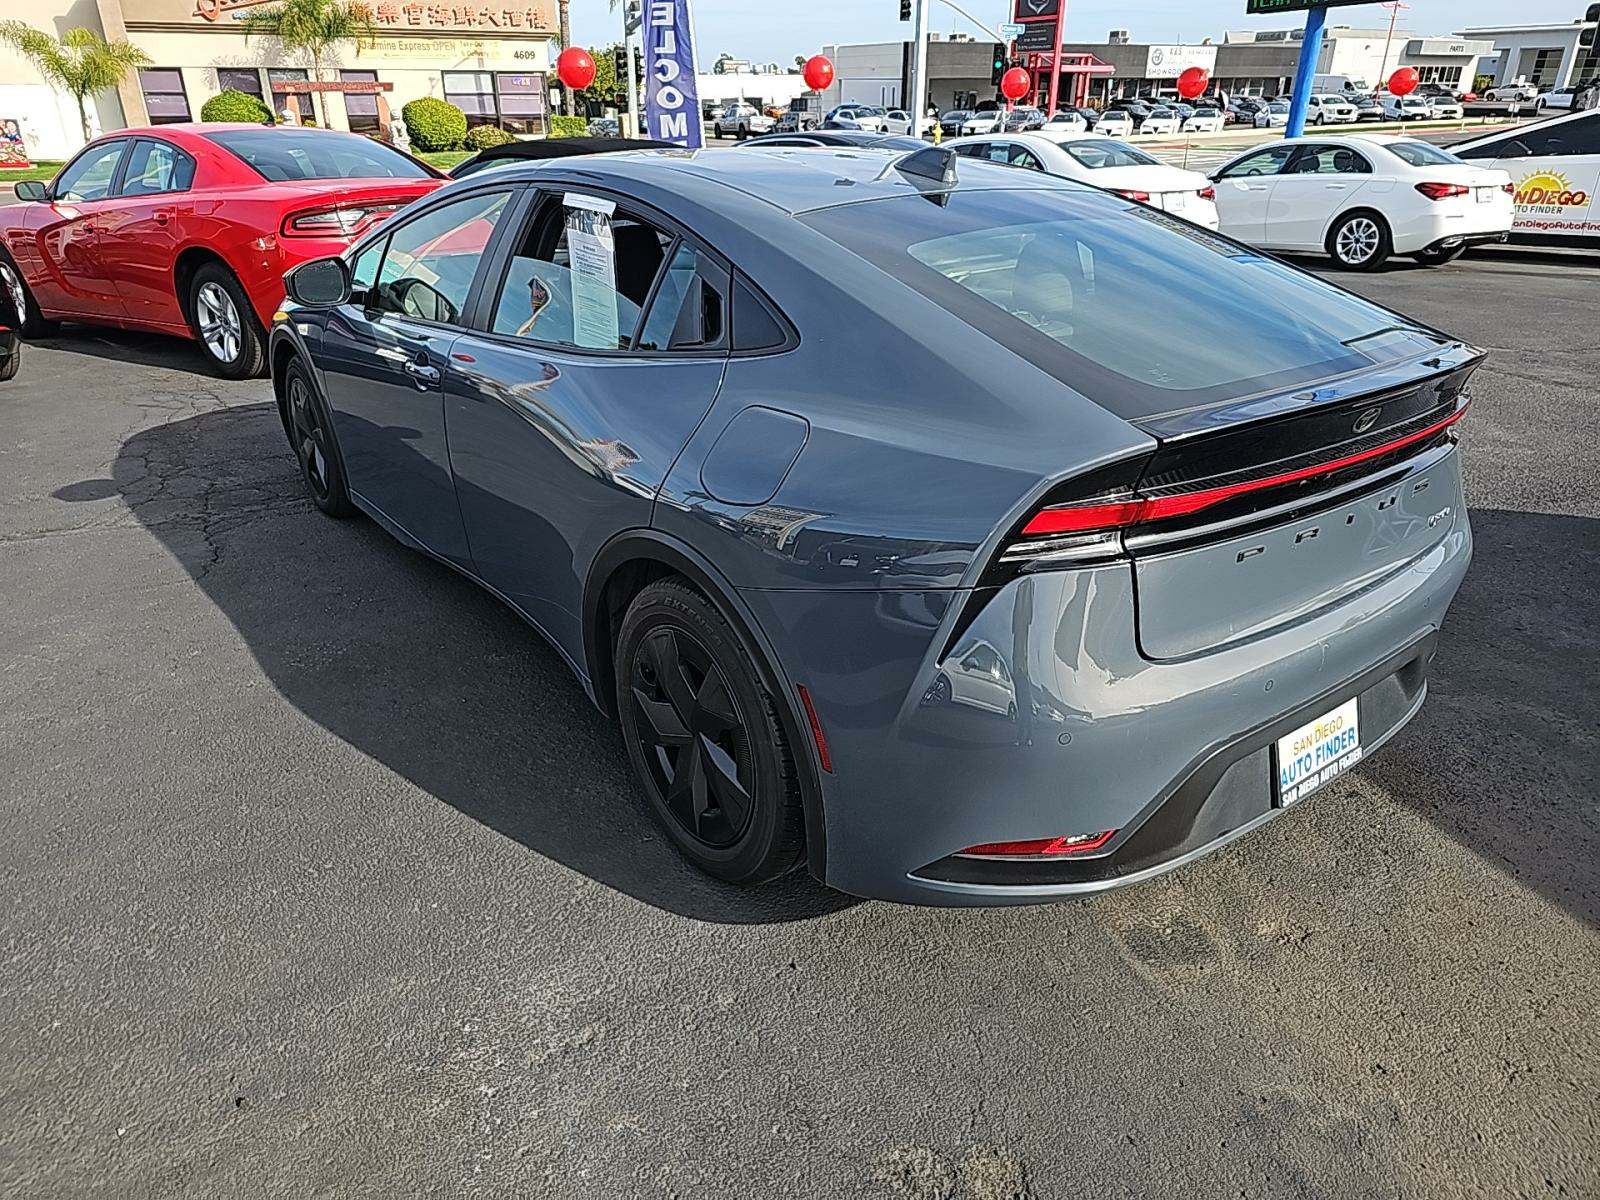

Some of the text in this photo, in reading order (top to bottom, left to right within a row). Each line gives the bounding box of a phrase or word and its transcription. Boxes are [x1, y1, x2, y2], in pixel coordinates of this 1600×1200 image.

[399, 41, 431, 52] Express
[433, 42, 456, 51] OPEN
[1449, 45, 1465, 53] PARTS
[513, 51, 535, 60] 4609
[1148, 68, 1183, 76] SHOWROO
[1530, 205, 1564, 214] FINDER
[1293, 716, 1343, 756] SAN DIEGO
[1281, 726, 1356, 786] AUTO FINDER
[1320, 761, 1339, 784] AUTO
